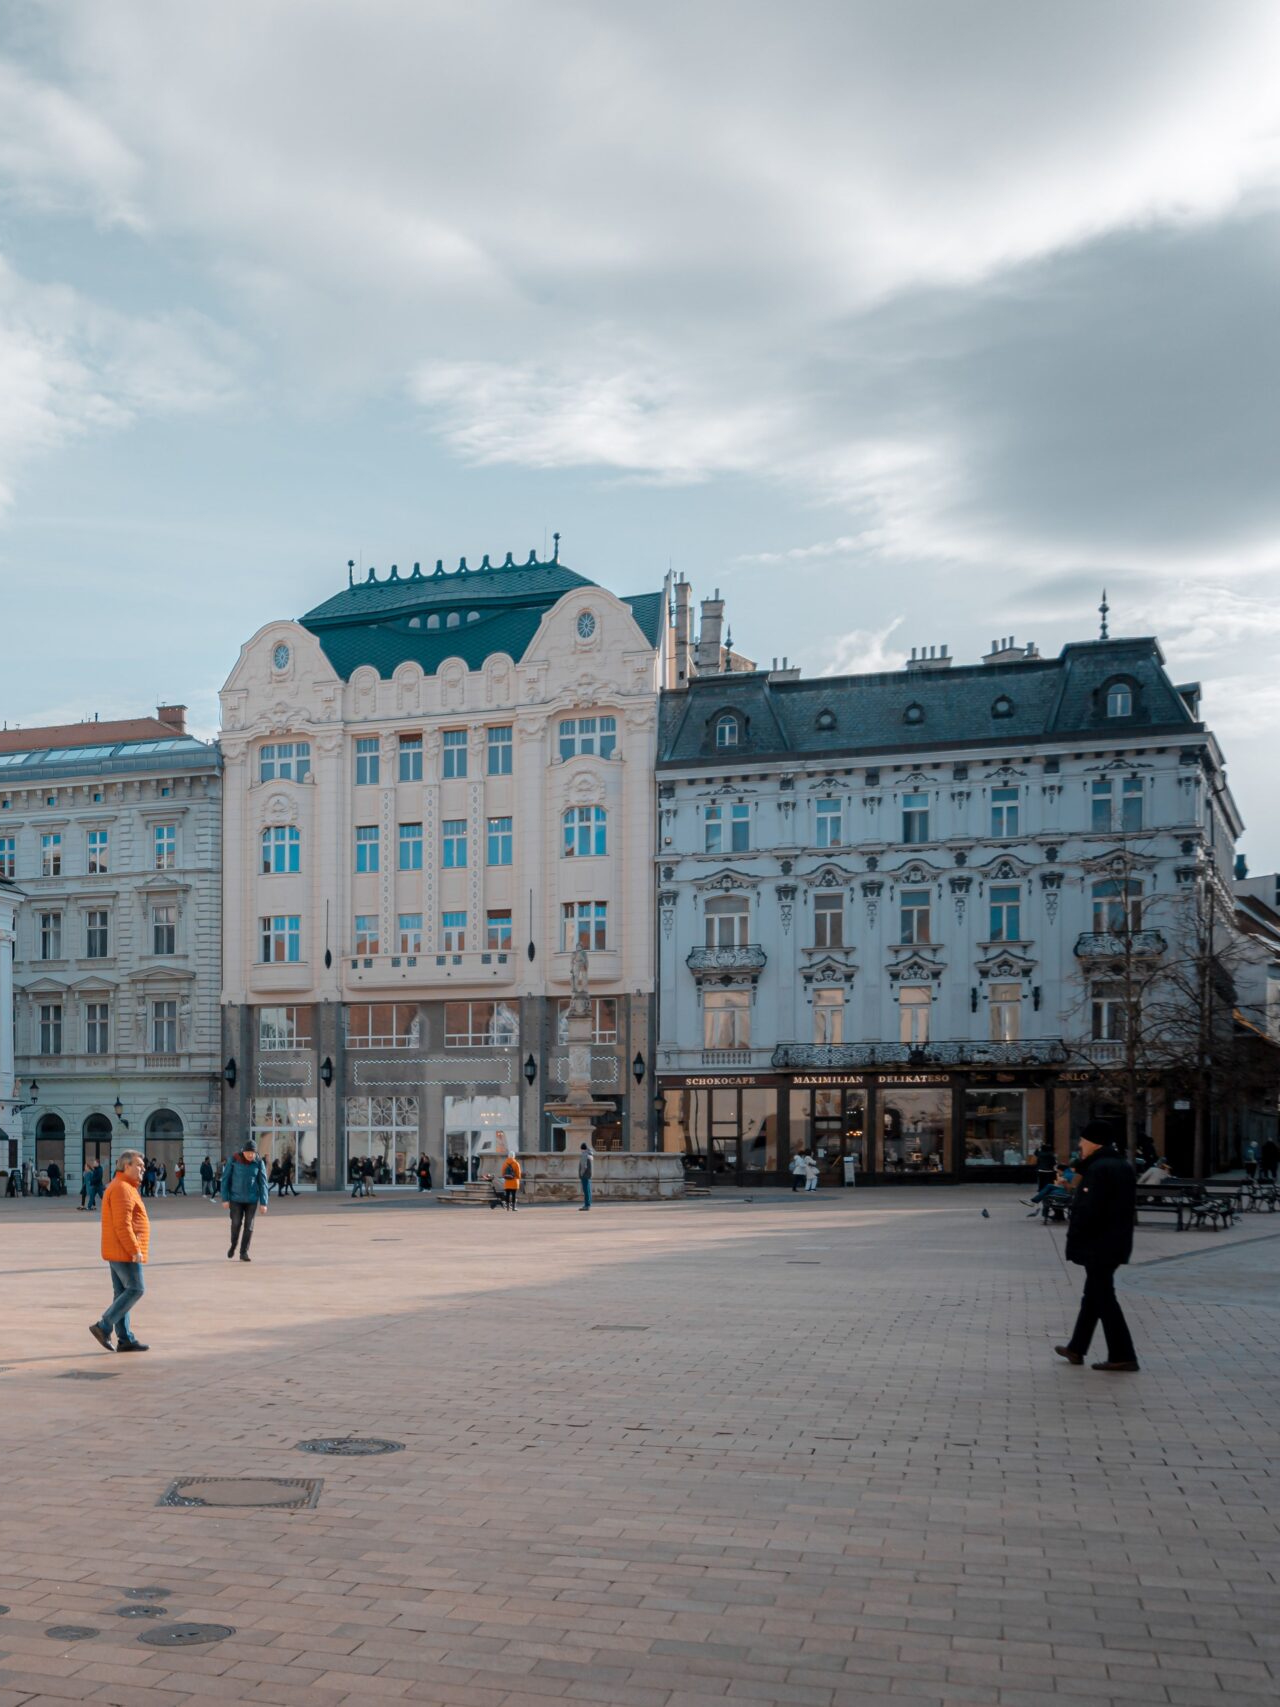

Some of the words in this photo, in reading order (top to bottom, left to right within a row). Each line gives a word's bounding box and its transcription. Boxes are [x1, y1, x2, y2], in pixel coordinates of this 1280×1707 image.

[686, 1077, 756, 1085] SCHOKOCAFE
[793, 1075, 864, 1084] MAXIMILIAN
[878, 1074, 950, 1083] DELIKATESO
